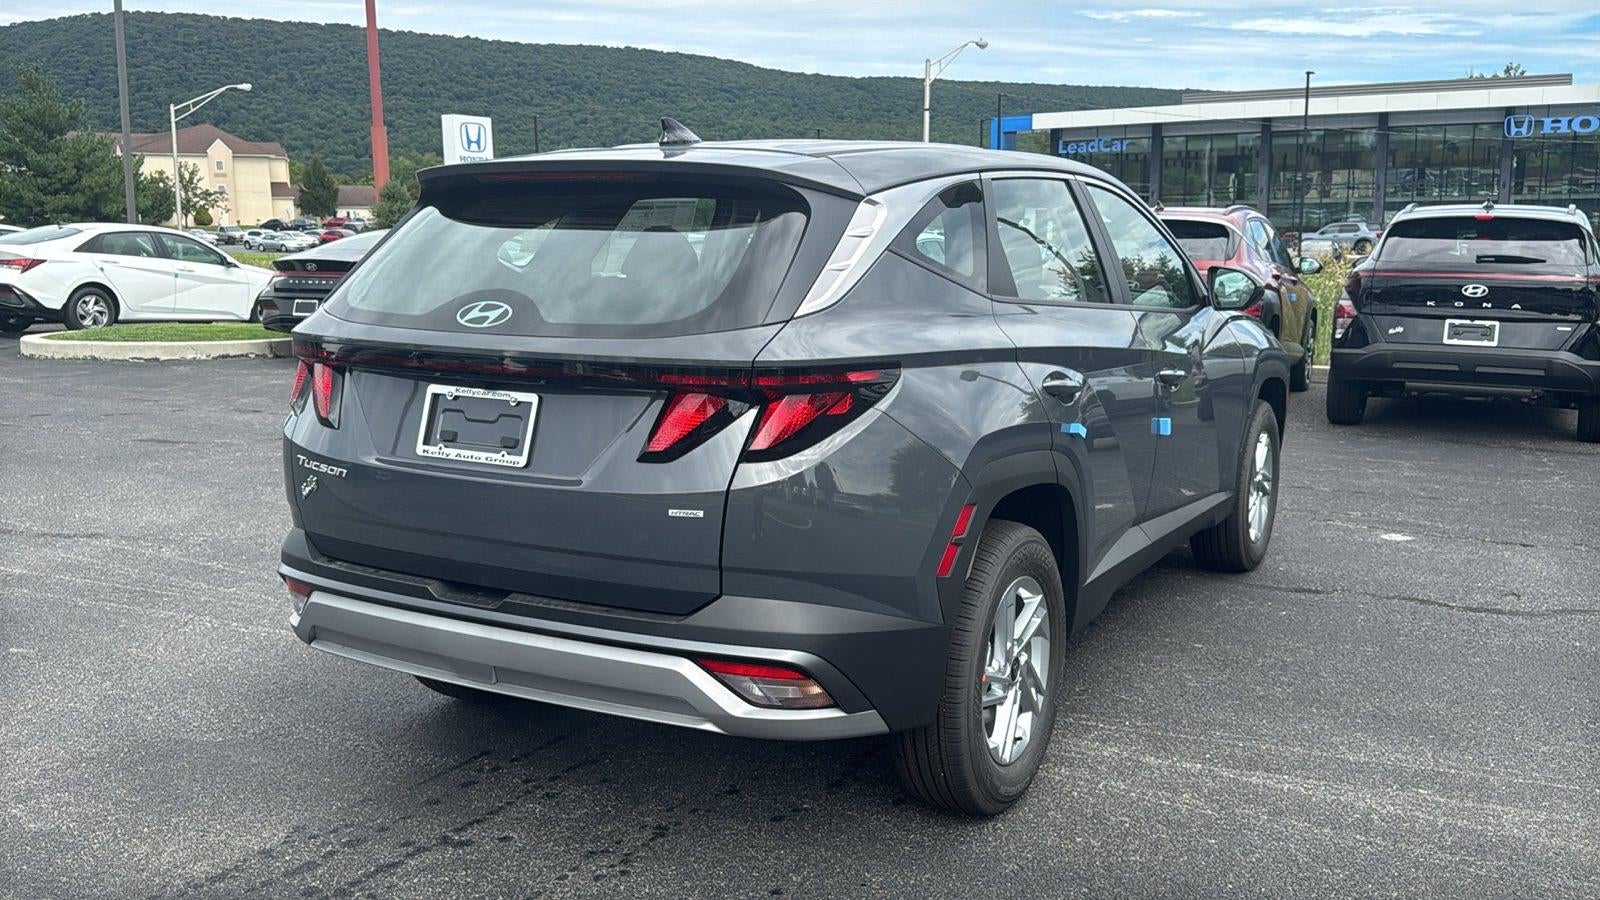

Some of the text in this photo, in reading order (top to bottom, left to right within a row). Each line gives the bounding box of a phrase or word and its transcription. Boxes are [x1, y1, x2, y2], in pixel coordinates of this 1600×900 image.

[1058, 137, 1128, 154] LeadCar
[1426, 300, 1522, 310] KONA
[455, 387, 511, 399] Kellycar.com
[422, 449, 520, 465] Kelly Auto Group
[297, 454, 347, 477] Tucson
